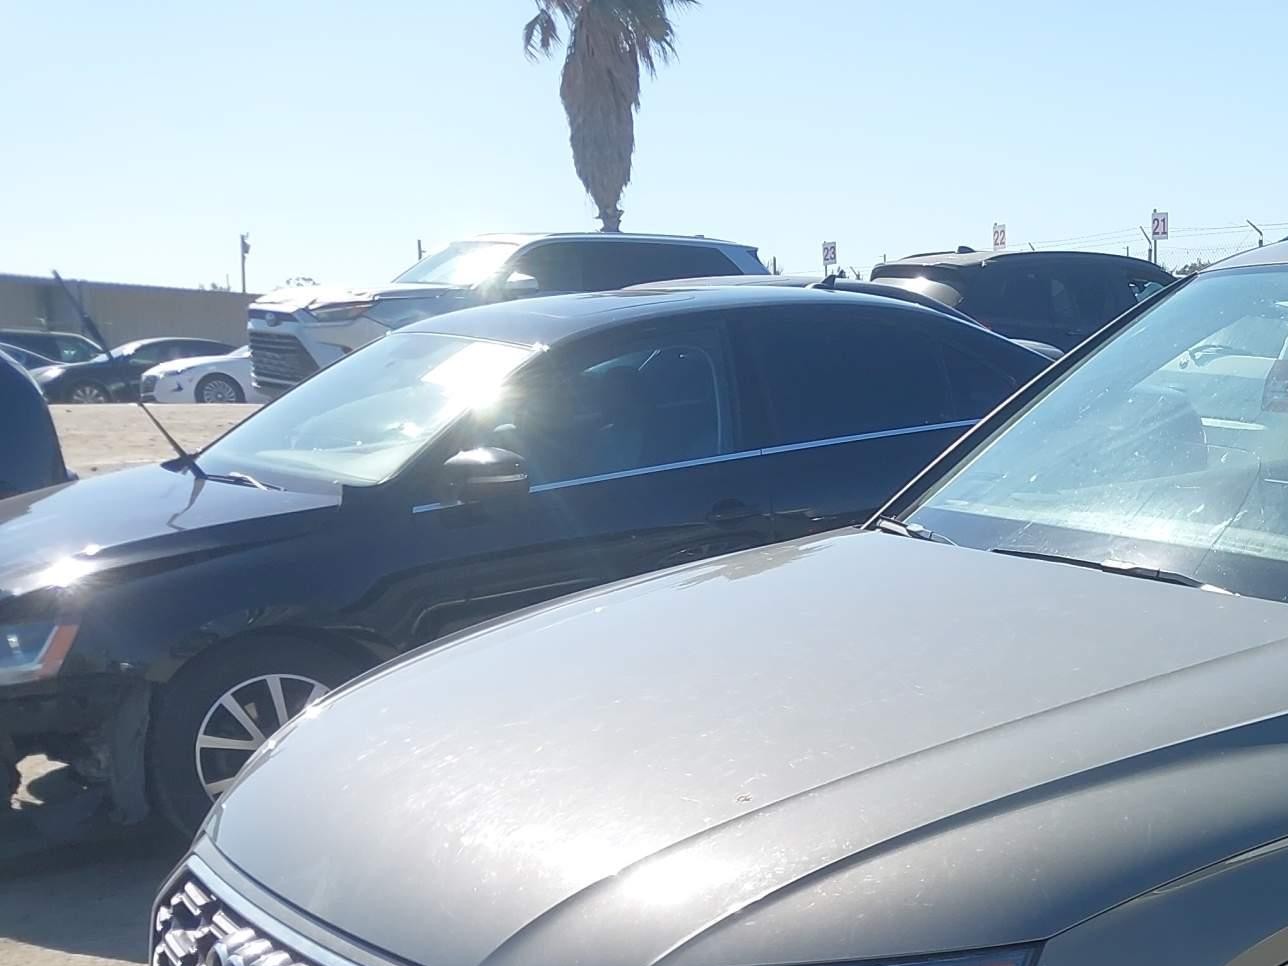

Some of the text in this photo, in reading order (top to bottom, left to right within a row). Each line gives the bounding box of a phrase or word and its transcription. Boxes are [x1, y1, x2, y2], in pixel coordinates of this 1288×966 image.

[1152, 217, 1167, 235] 21
[993, 230, 1006, 246] 22
[823, 246, 837, 261] 23
